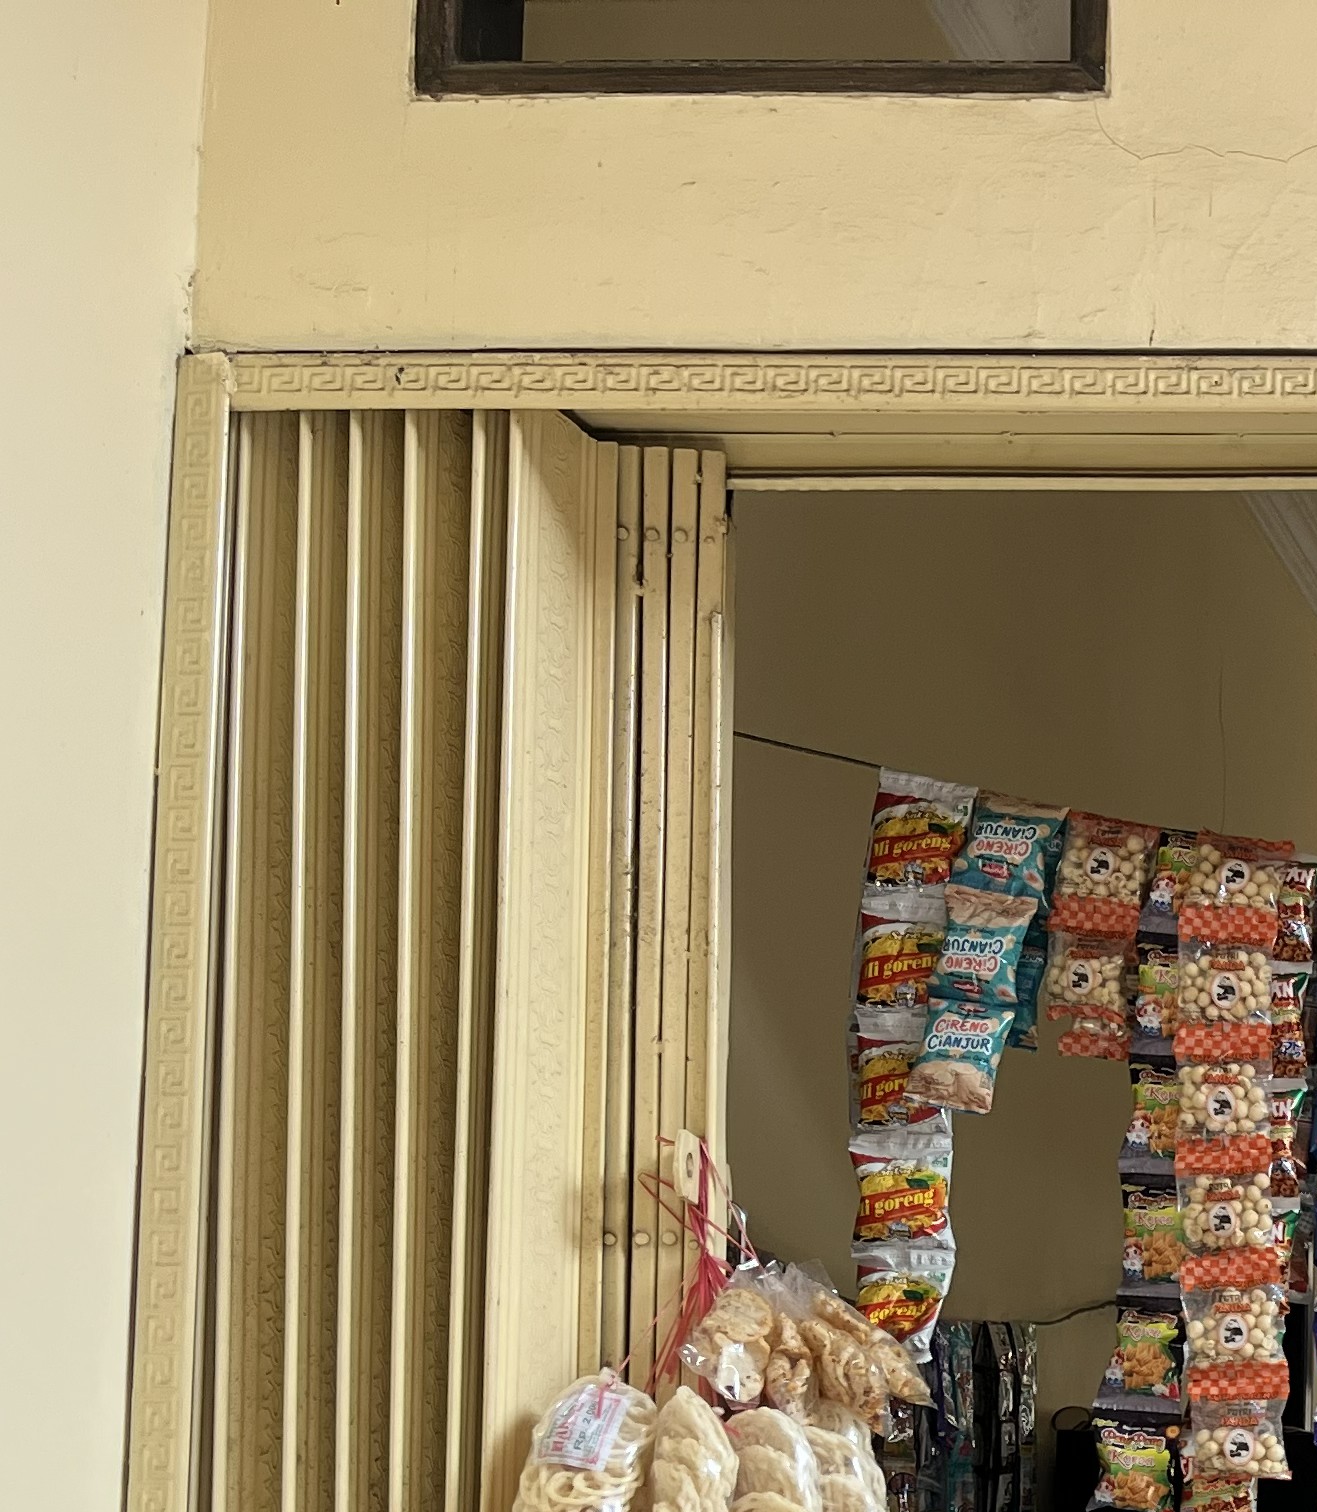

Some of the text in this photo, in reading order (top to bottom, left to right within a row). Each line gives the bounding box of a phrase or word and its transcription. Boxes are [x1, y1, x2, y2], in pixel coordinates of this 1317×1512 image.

[893, 836, 951, 854] goreng
[874, 1189, 934, 1217] goreng
[869, 1301, 928, 1324] goreng
